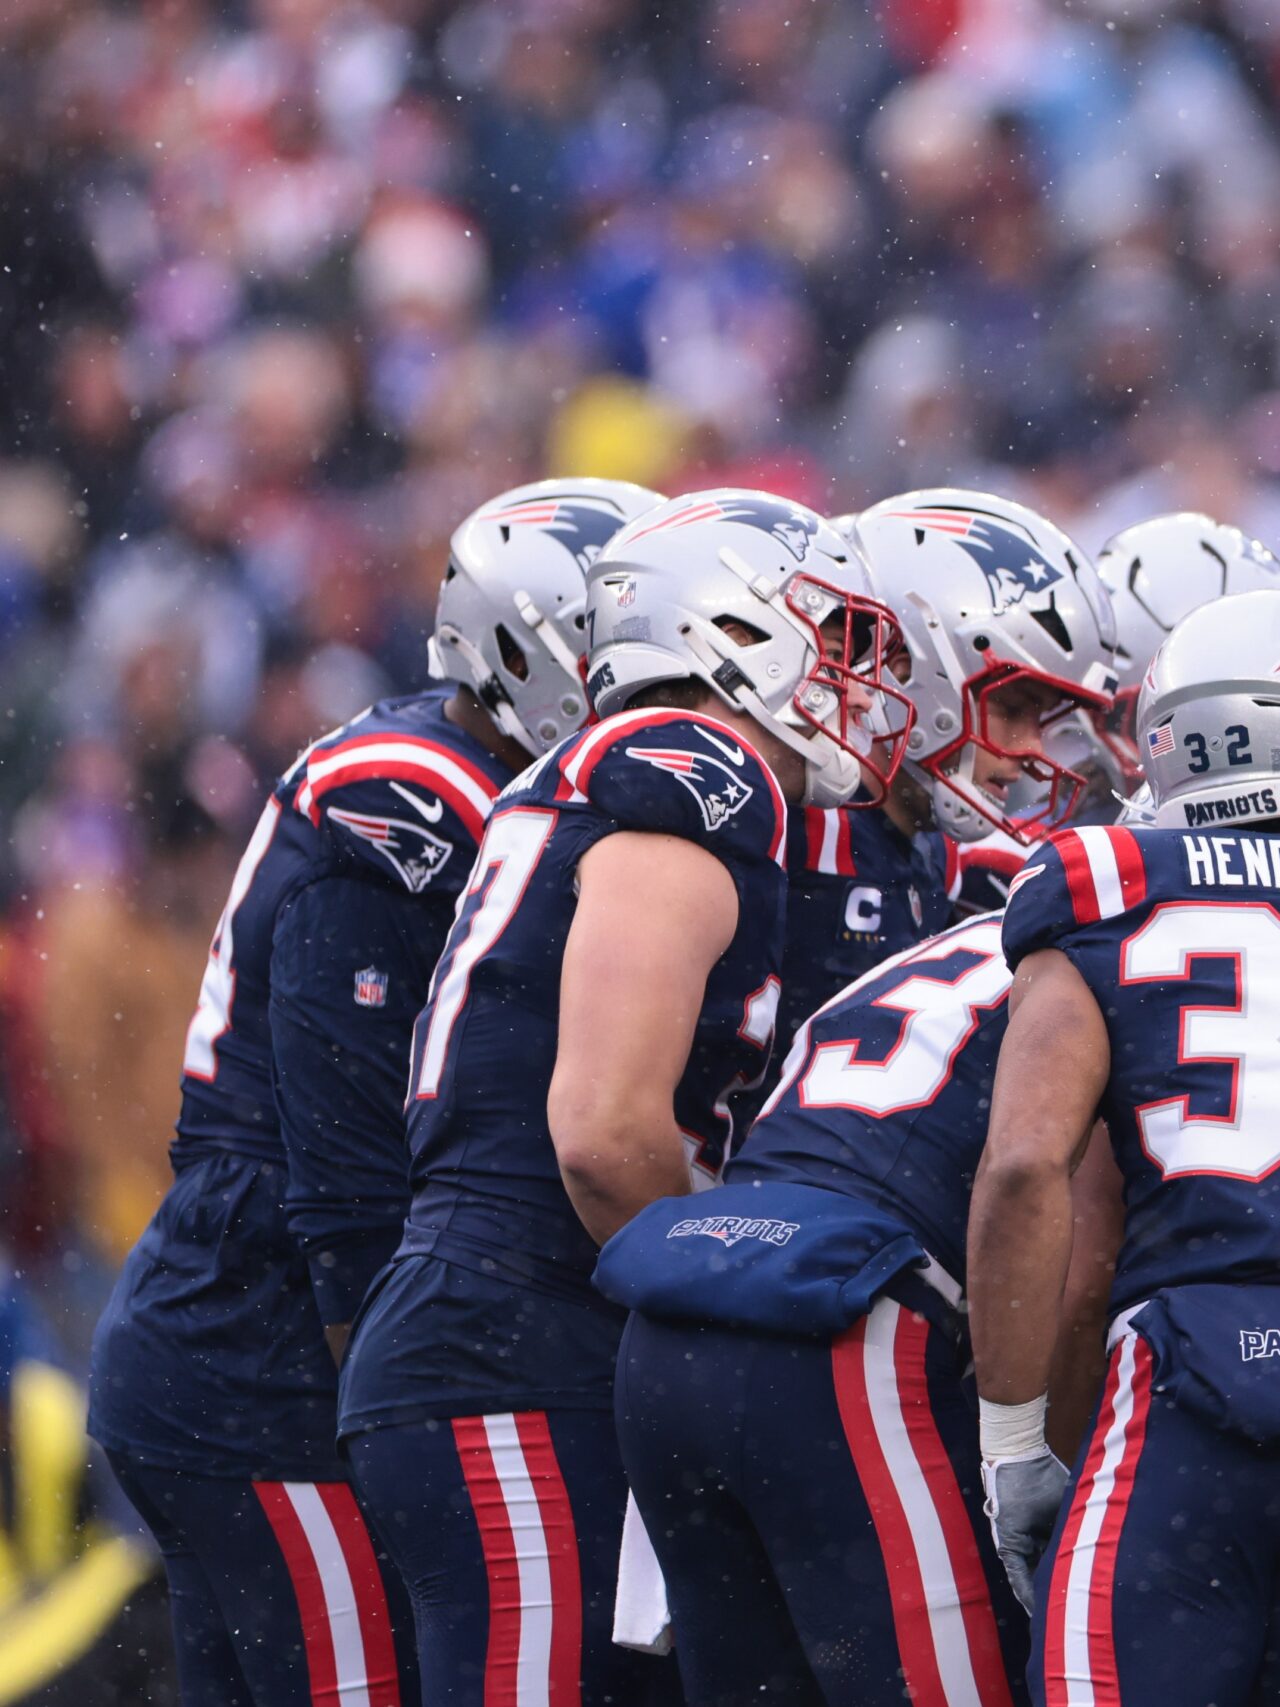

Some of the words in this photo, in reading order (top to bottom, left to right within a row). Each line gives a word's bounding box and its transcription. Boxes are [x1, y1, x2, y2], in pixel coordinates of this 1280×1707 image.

[1183, 788, 1278, 827] PATRIOTS
[845, 886, 882, 933] C
[748, 908, 1014, 1120] 3
[666, 1216, 801, 1247] PATRIOTS
